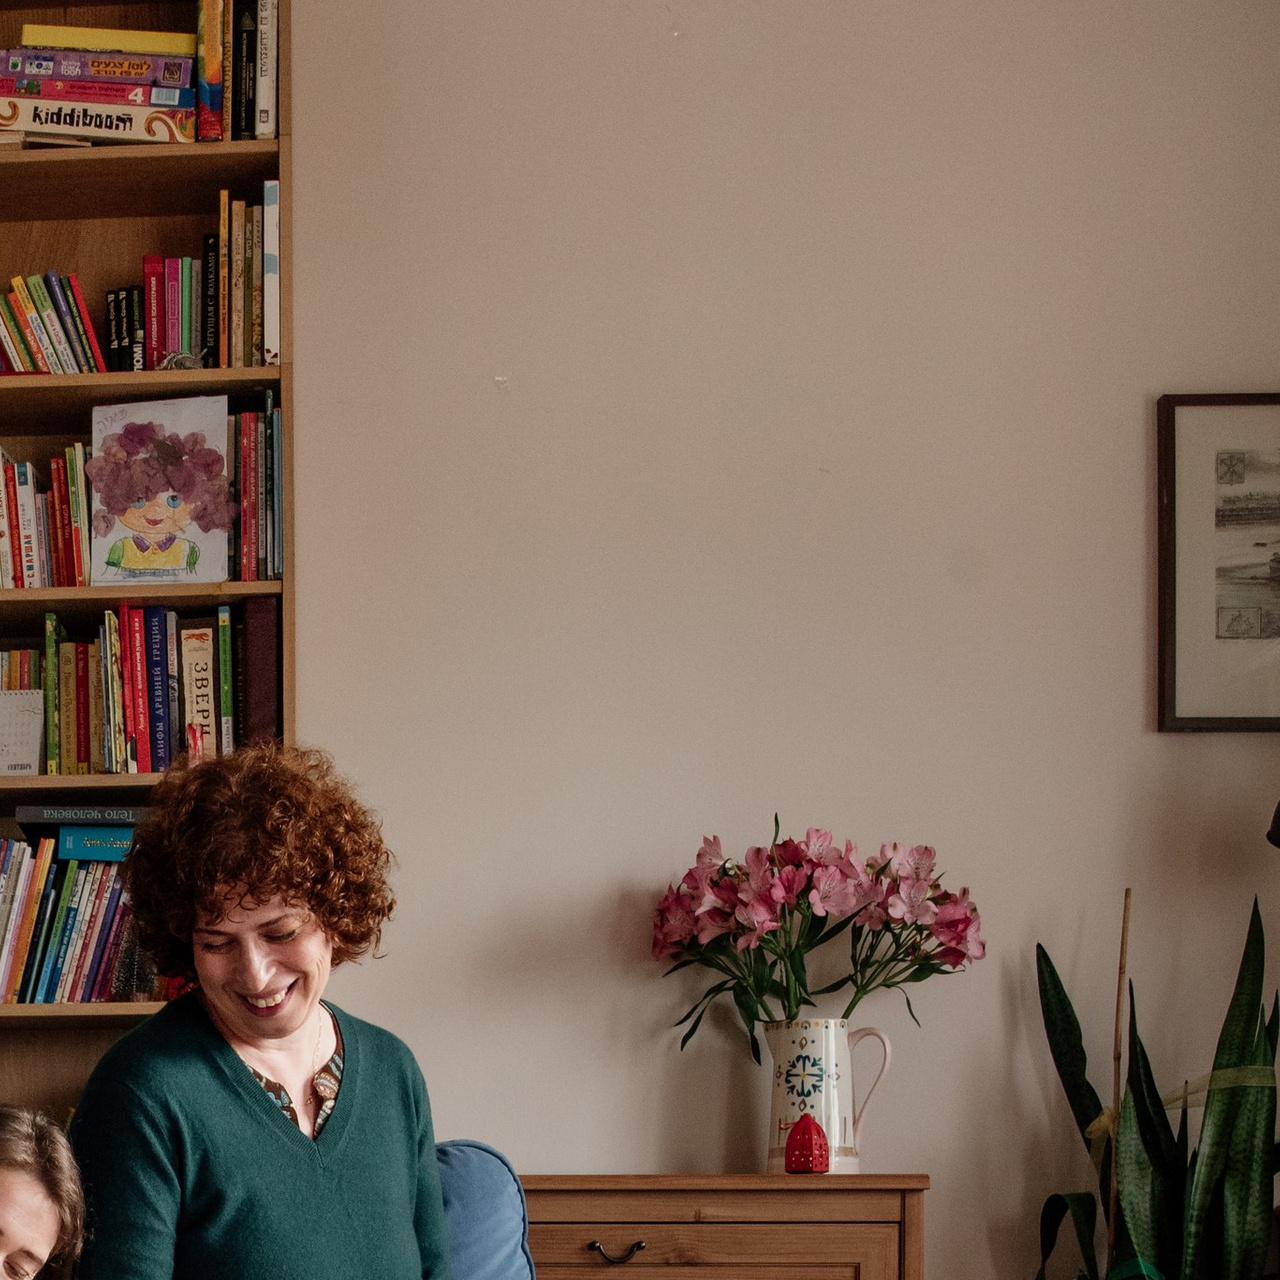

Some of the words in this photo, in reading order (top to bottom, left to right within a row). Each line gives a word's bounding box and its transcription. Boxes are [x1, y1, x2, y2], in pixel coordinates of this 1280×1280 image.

[127, 87, 144, 104] 4
[206, 252, 216, 295] ВОЛКАМИ
[207, 297, 215, 305] С
[206, 305, 216, 347] БЕГУЩАЯ
[19, 503, 27, 531] КРУГЛЫЙ
[149, 617, 162, 662] ГРЕЦИИ
[166, 631, 177, 676] НАСКВОЗЬ
[151, 666, 164, 718] ДРЕВНЕЙ
[193, 661, 212, 737] ЗВЕРИ
[153, 721, 165, 758] МИФЫ
[43, 808, 101, 820] человека
[102, 808, 136, 823] Тело
